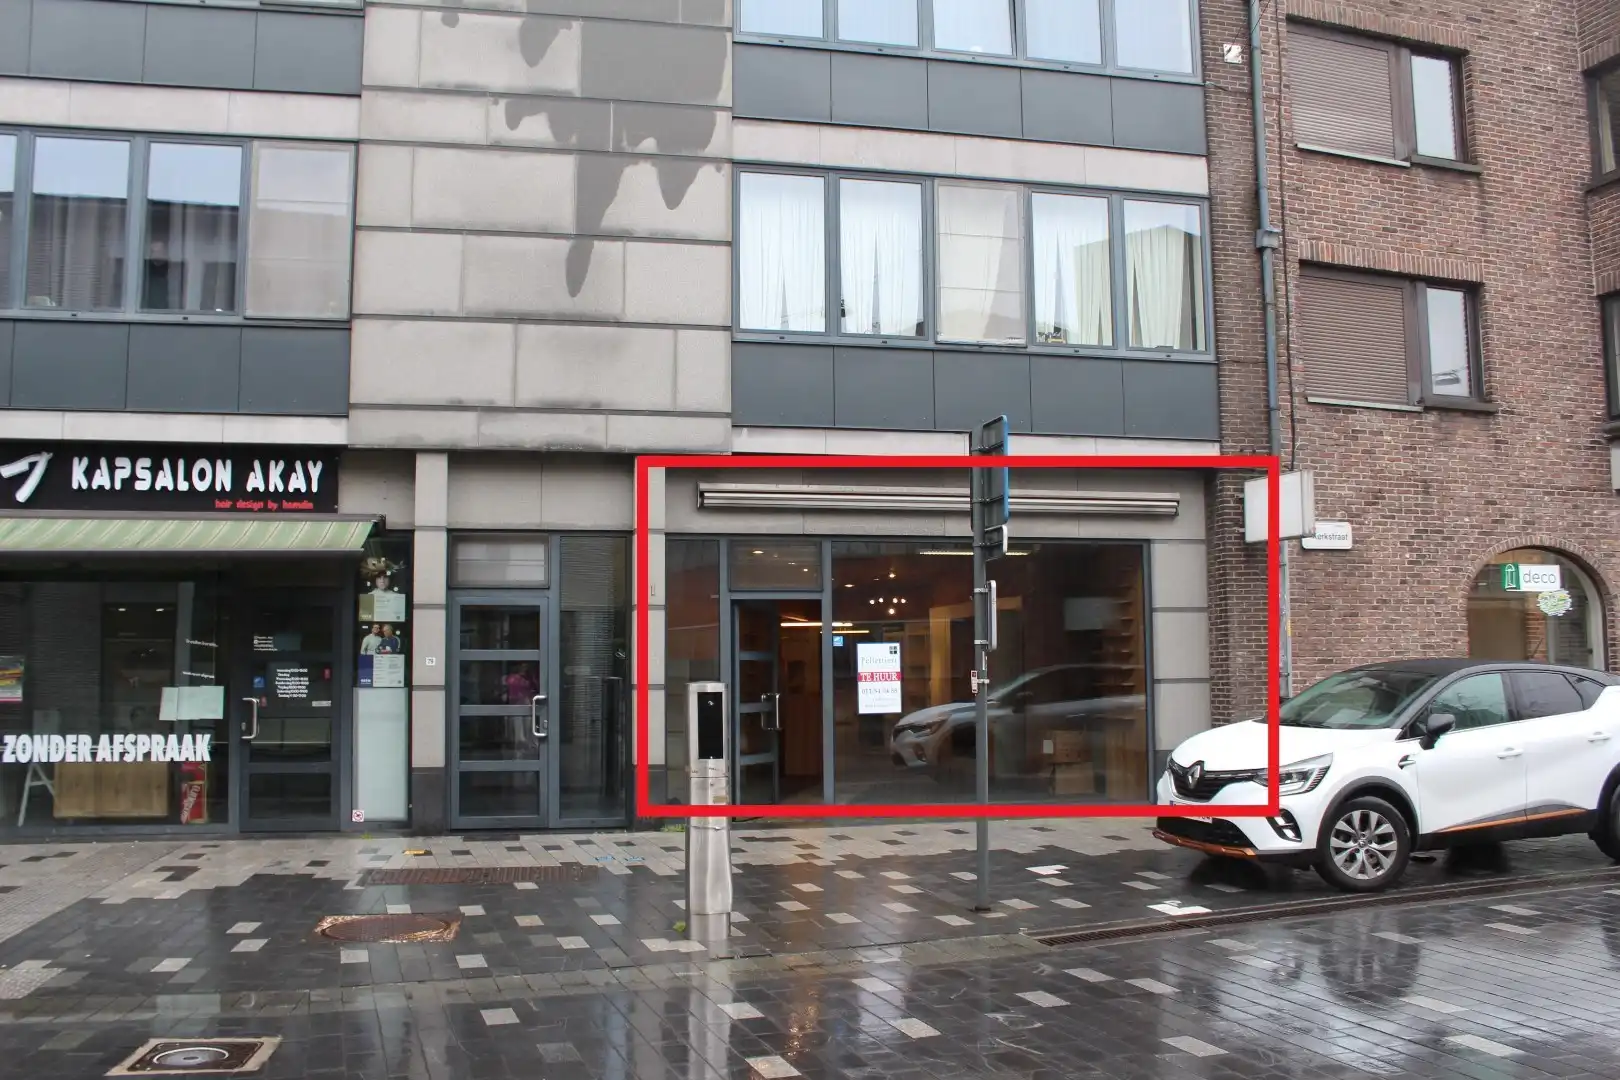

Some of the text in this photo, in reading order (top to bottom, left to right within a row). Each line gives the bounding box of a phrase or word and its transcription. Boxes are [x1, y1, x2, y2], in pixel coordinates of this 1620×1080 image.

[71, 456, 323, 494] KAPSALON AKAY
[236, 498, 264, 511] design
[267, 499, 279, 511] by
[1522, 569, 1557, 584] deco
[861, 672, 898, 682] TE HUUR
[2, 733, 211, 763] ZONDER AFSPRAAK
